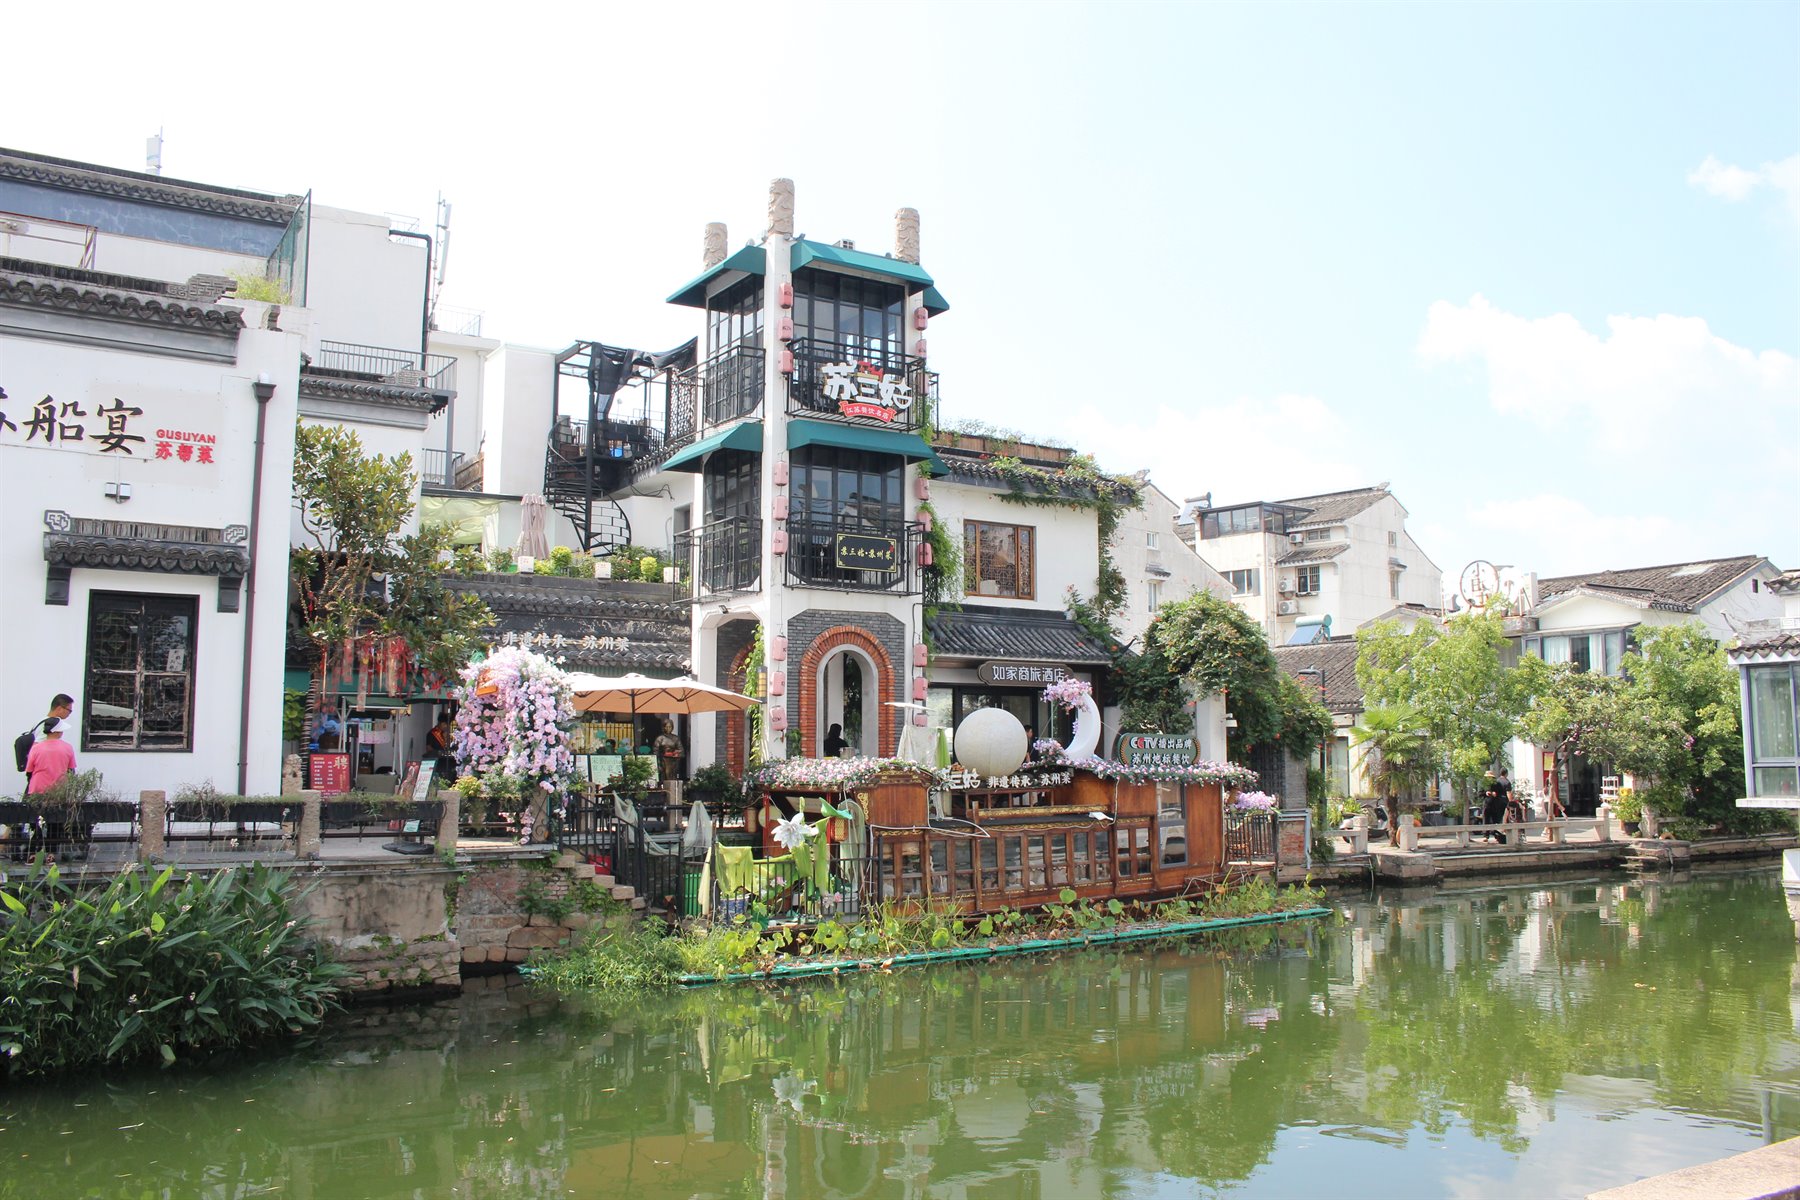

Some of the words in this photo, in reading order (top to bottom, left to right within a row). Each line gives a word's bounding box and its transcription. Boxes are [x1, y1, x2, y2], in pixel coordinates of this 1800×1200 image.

[821, 360, 912, 409] 苏三姑
[0, 386, 146, 455] 船宴
[156, 429, 216, 444] GUSUYAN
[155, 441, 215, 464] 苏帮菜
[992, 665, 1065, 683] 如家商旅酒店
